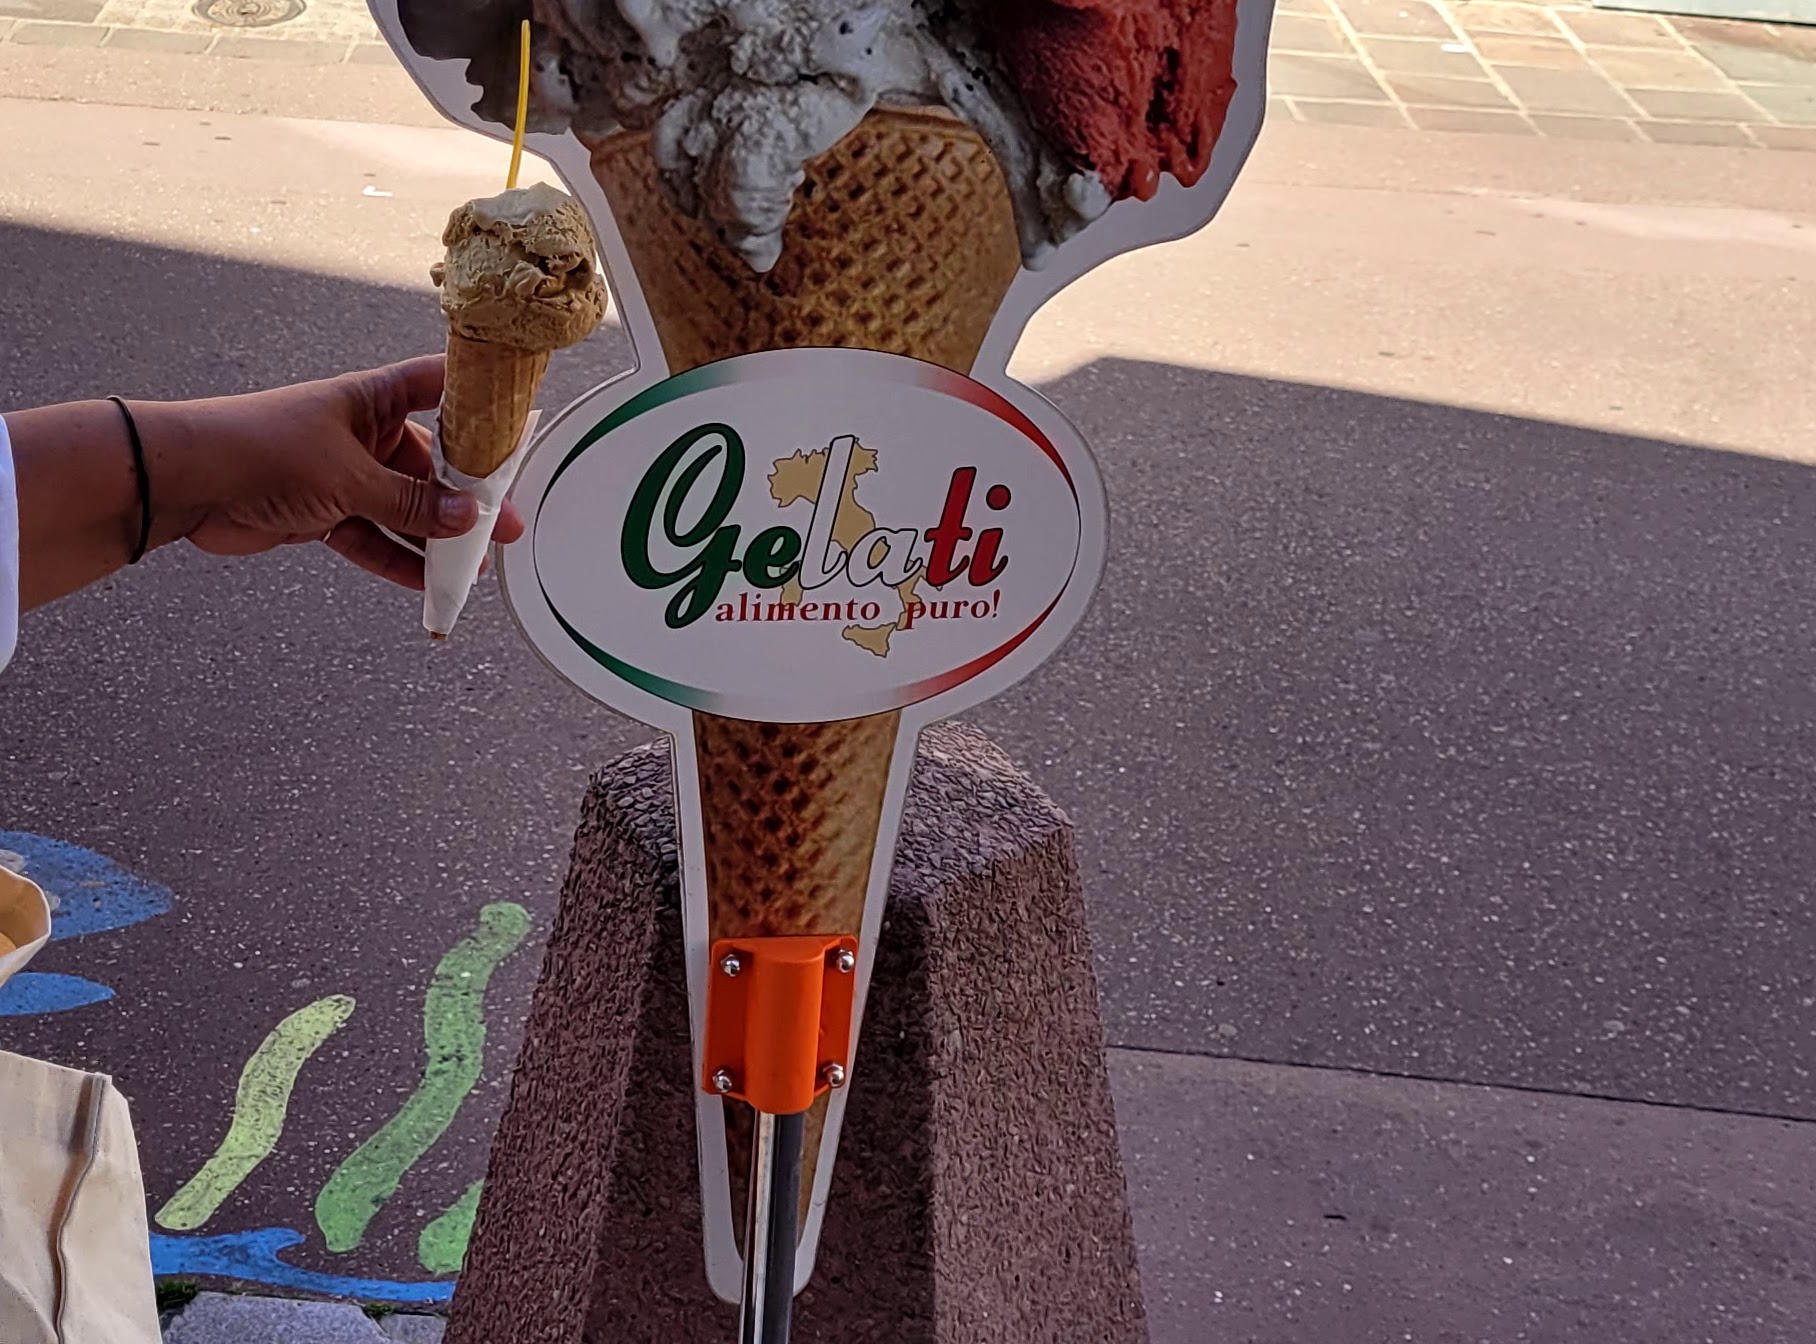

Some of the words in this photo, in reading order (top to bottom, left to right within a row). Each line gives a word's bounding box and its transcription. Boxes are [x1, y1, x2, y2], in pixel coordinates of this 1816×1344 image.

[620, 422, 1012, 629] Gelati
[714, 592, 882, 624] alimento
[904, 589, 1001, 632] puro!
